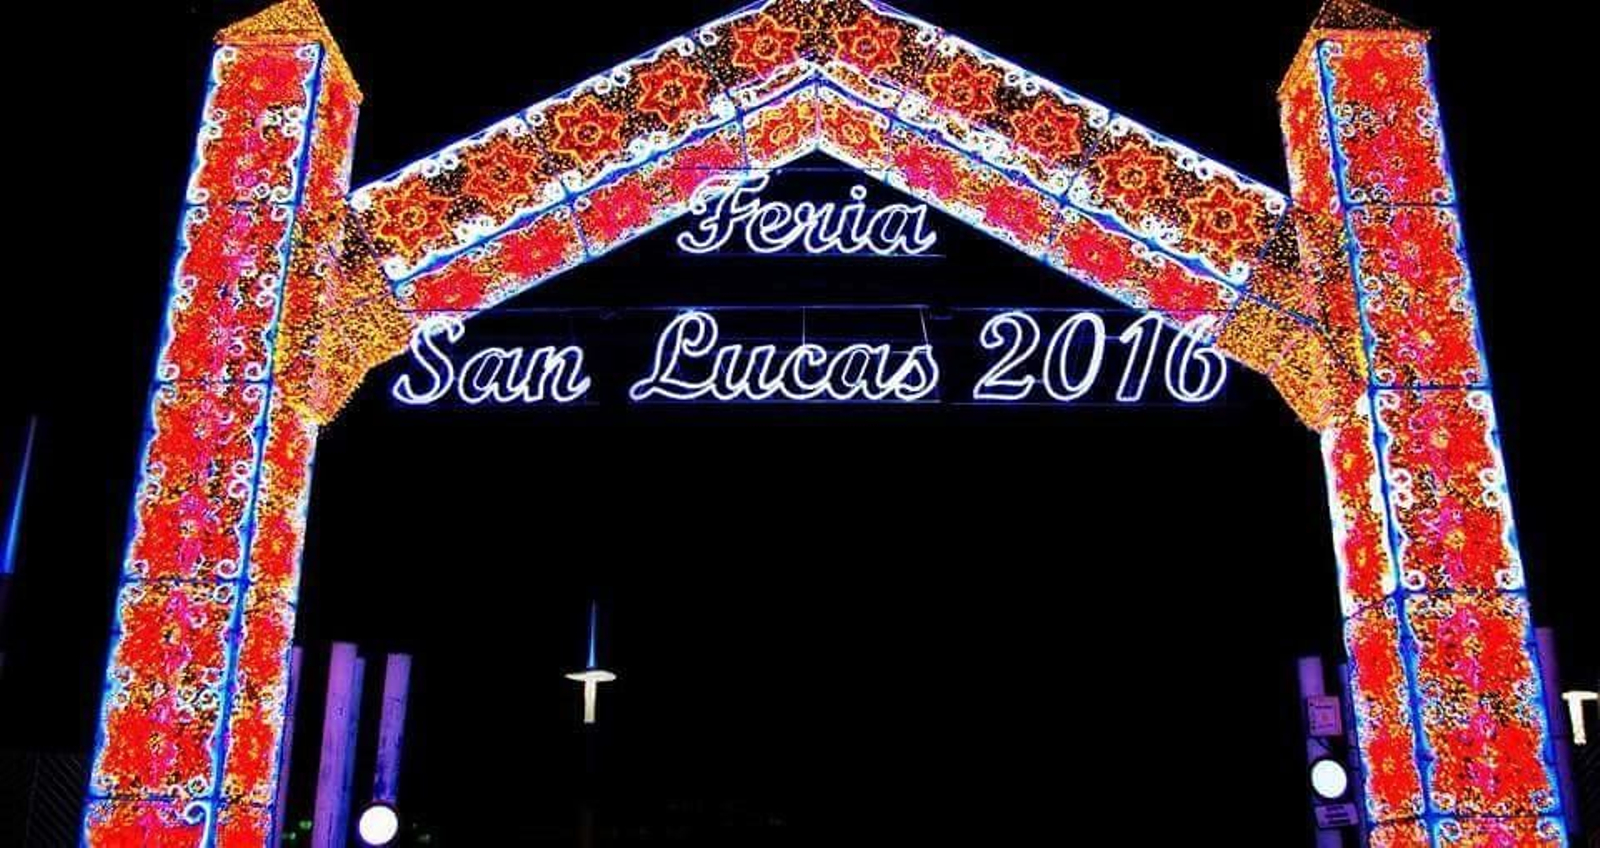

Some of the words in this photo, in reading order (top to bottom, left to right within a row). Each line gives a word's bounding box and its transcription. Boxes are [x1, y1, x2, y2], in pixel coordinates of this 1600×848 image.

[677, 172, 937, 254] Feria
[393, 313, 591, 403] San
[629, 310, 940, 400] Lucas
[972, 310, 1228, 402] 2016
